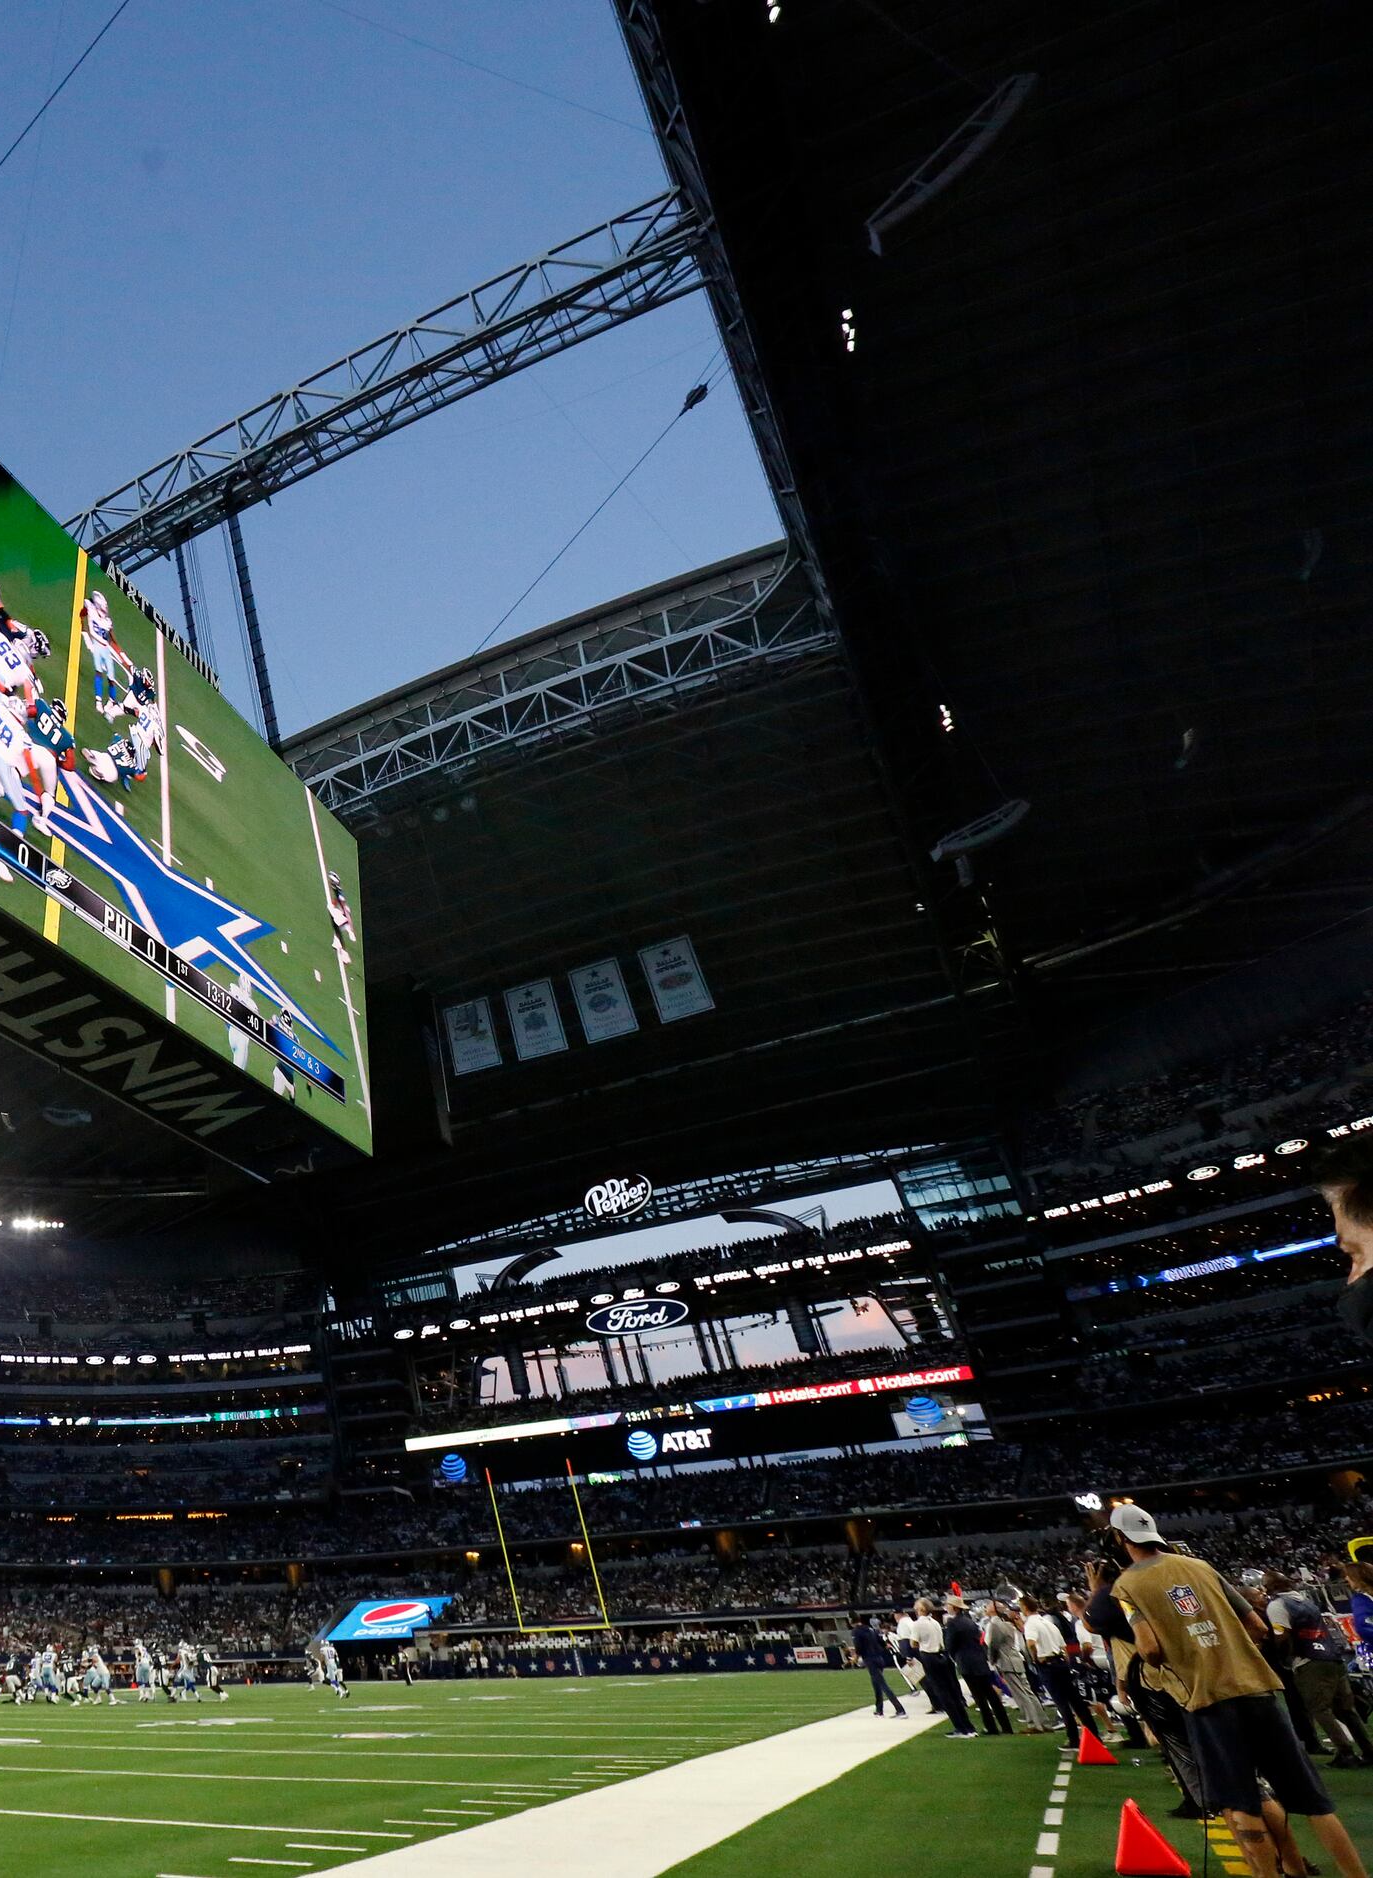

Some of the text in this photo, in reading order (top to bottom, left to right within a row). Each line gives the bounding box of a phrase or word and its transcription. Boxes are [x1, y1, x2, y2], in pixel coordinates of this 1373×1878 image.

[106, 559, 220, 692] AT&T STADIUM
[37, 712, 64, 745] 91
[17, 843, 29, 869] 0
[104, 904, 320, 1074] PHI 0 1ST 13:12 :40 2ND & 3
[1326, 1125, 1351, 1138] THE
[1233, 1153, 1266, 1169] Ford
[605, 1178, 629, 1198] Dr
[1043, 1179, 1173, 1219] FORD IS THE BEST IN TEXAS
[694, 1240, 912, 1287] THE OFFICIAL VEHICLE OF THE DALLAS COWBOYS
[479, 1314, 500, 1325] FORD
[500, 1312, 509, 1321] IS
[508, 1309, 524, 1320] THE
[524, 1306, 544, 1317] BEST
[545, 1304, 555, 1314] IN
[555, 1300, 579, 1312] TEXAS
[607, 1304, 668, 1331] Ford
[876, 1367, 959, 1390] Hotels.com
[772, 1381, 851, 1403] Hotels.com
[625, 1409, 651, 1422] 13:11
[662, 1428, 712, 1452] AT&T
[1177, 1596, 1200, 1613] NFL
[353, 1625, 409, 1637] pepsi
[1186, 1620, 1218, 1637] MEDIA
